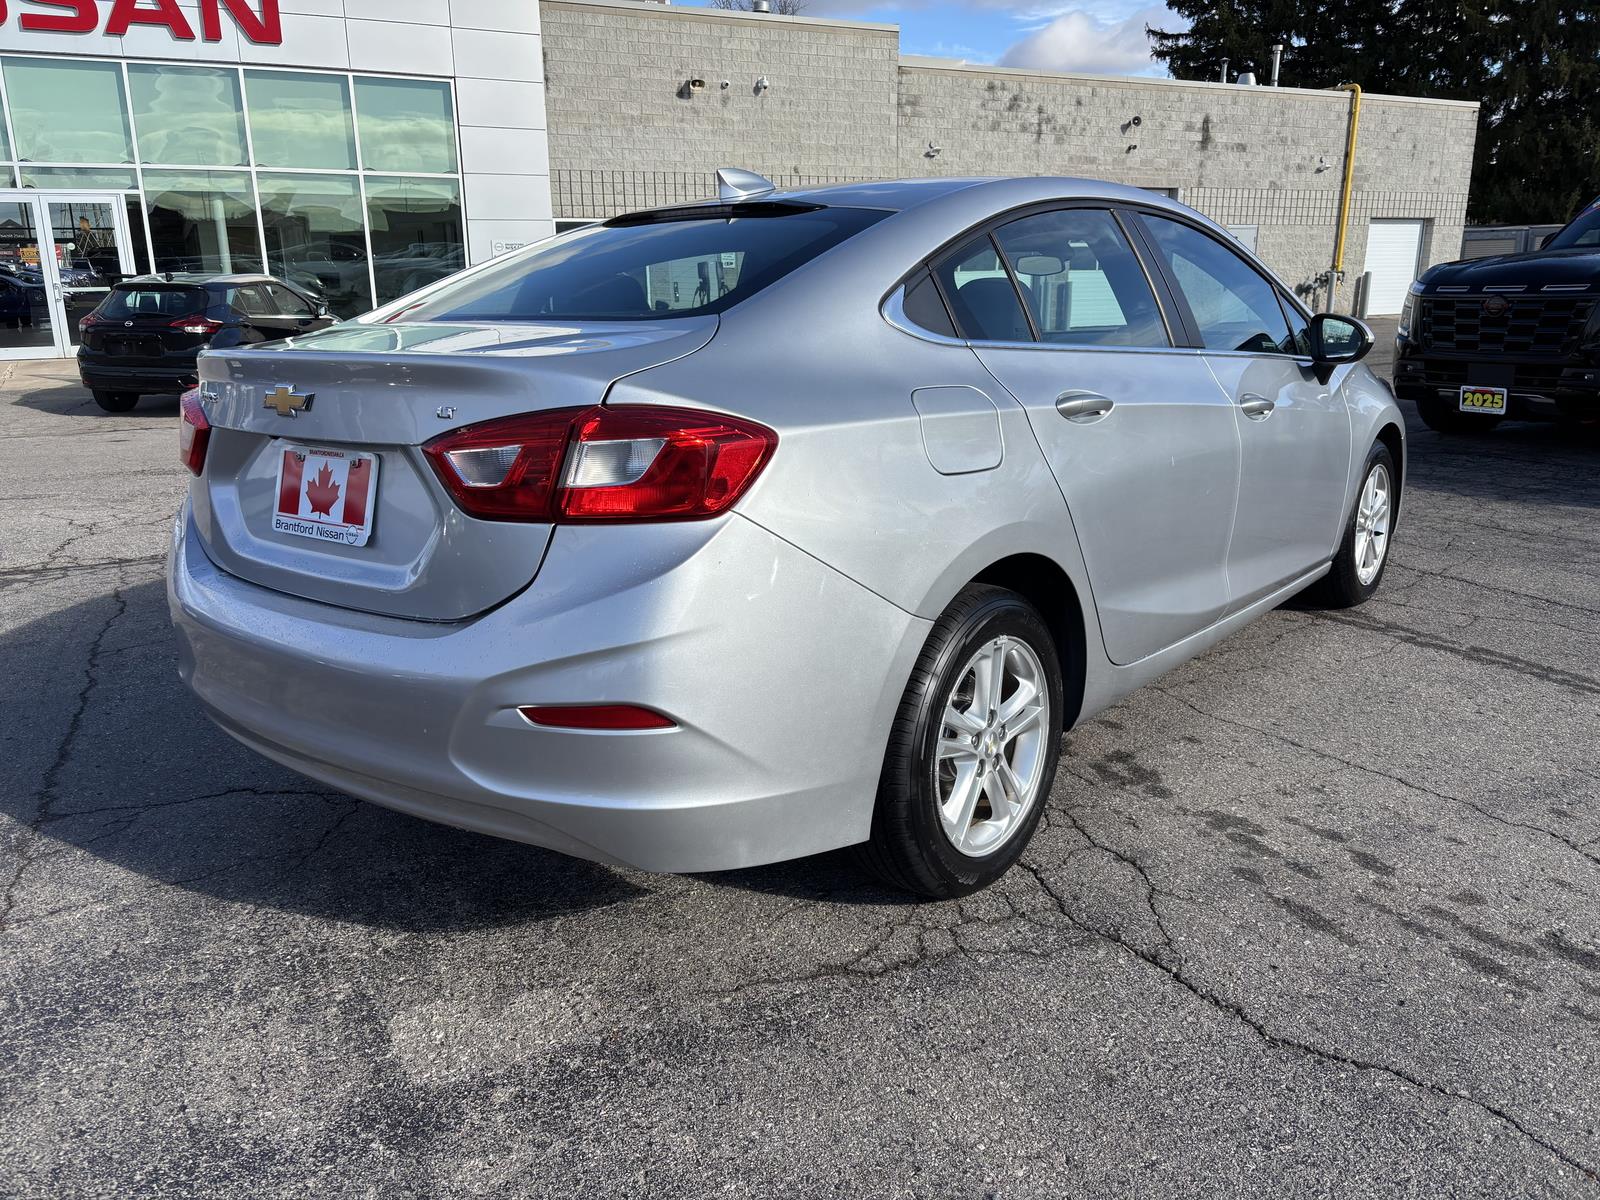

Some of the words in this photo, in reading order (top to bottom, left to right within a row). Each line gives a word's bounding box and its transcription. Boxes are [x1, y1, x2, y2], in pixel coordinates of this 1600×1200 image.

[1463, 392, 1503, 408] 2025
[275, 518, 314, 535] Brantford
[316, 526, 345, 541] Nissan
